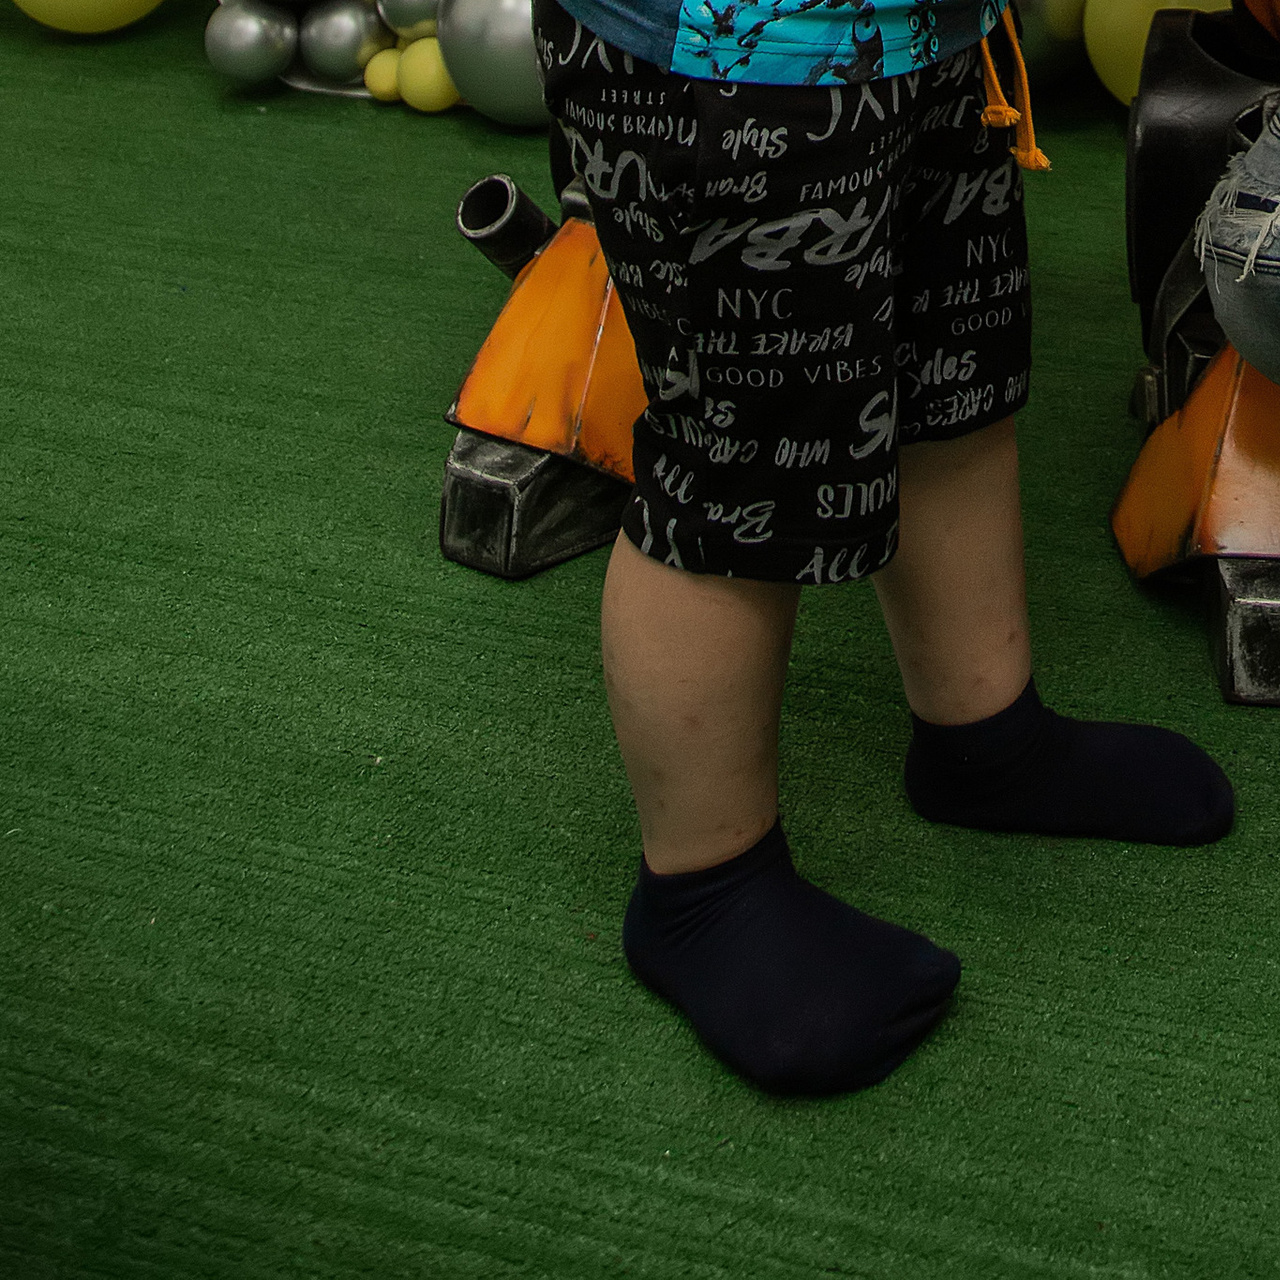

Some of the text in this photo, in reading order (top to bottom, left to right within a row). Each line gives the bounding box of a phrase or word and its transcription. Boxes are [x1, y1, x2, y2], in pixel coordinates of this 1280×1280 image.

[600, 89, 667, 106] STREET
[722, 118, 788, 160] Style
[612, 198, 665, 243] Style
[967, 227, 1013, 268] NYC
[717, 287, 795, 321] NYC
[951, 307, 1012, 337] GOOD
[751, 323, 854, 356] BRAKE
[706, 364, 784, 388] GOOD
[803, 355, 883, 385] VIBES
[774, 435, 831, 469] WHO
